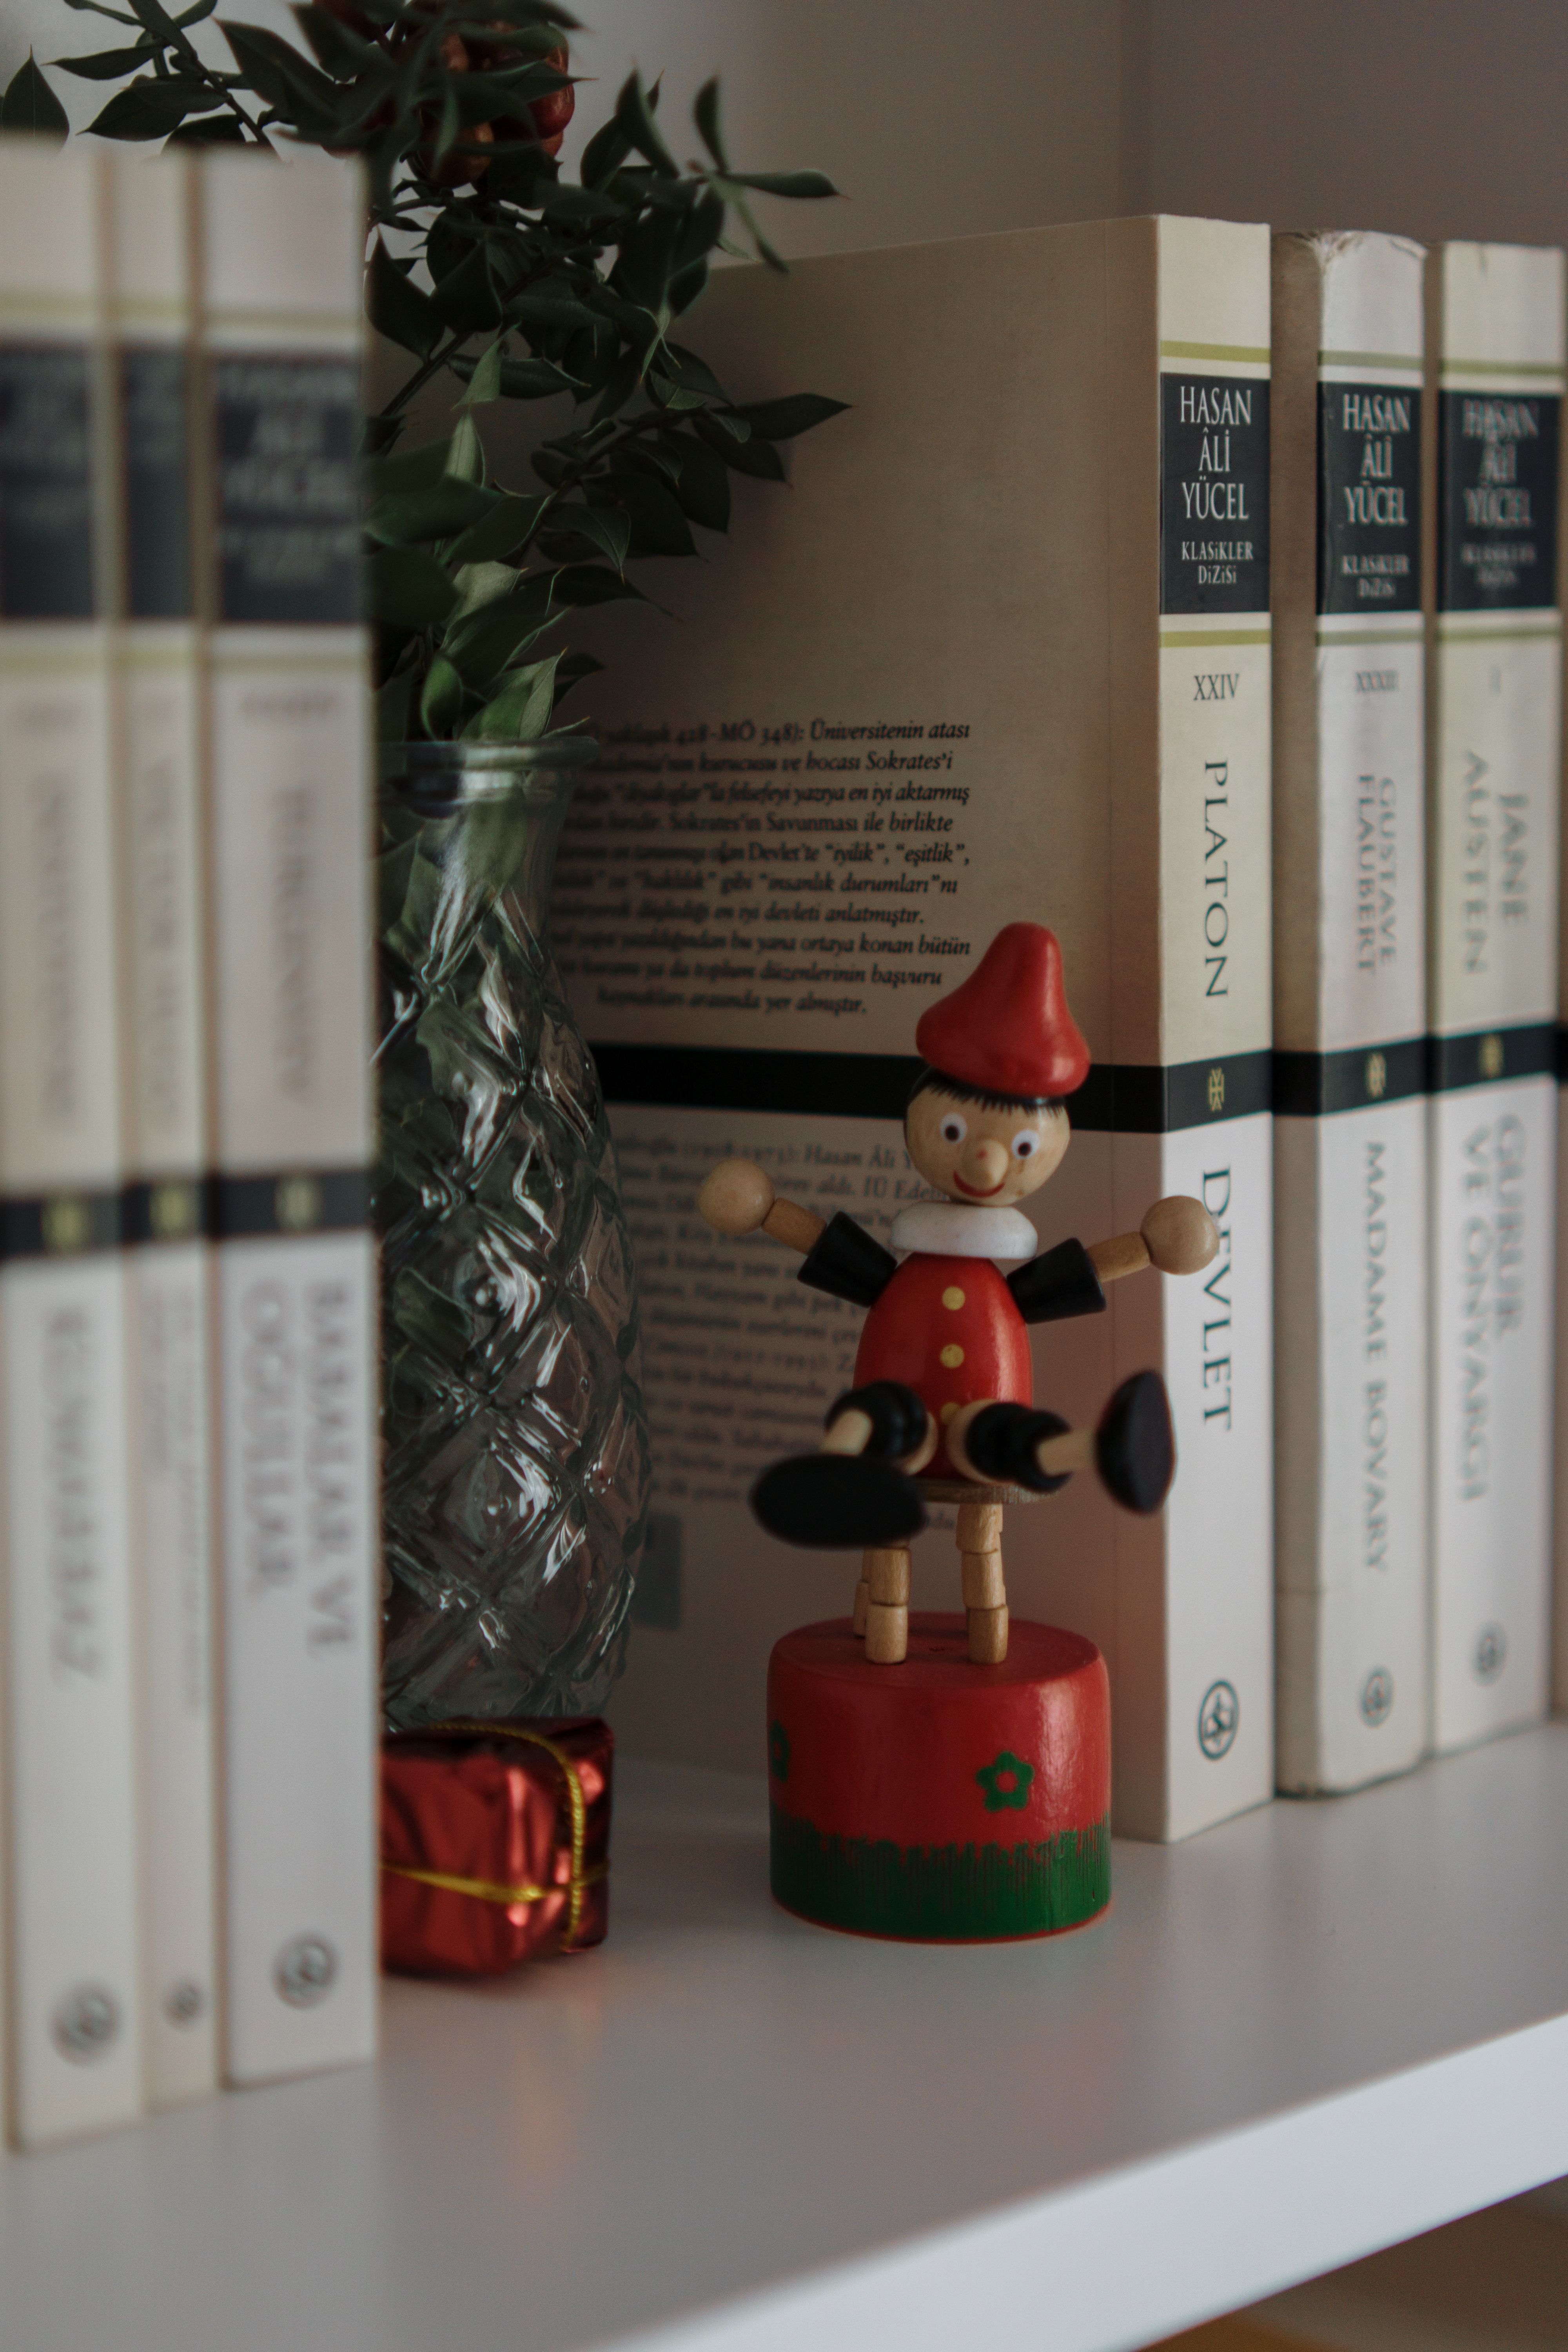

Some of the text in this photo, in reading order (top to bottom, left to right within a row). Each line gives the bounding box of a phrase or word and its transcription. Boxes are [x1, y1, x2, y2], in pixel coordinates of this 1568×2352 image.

[1180, 385, 1252, 425] HASAN
[1343, 393, 1410, 433] HASAN
[1198, 426, 1230, 472] ÂLİ
[1181, 475, 1249, 520] YÜCEL
[1344, 480, 1408, 525] YÜCEL
[1193, 673, 1239, 701] XXIV
[809, 718, 924, 741] Üniversitenin
[928, 722, 970, 739] atası
[806, 750, 861, 771] hocası
[866, 750, 953, 771] Sokrates'i
[848, 788, 869, 802] en
[871, 782, 892, 807] iyi
[895, 780, 970, 806] aktarmış
[766, 811, 858, 832] Savunması
[864, 811, 885, 832] ile
[889, 810, 953, 832] birlikte
[1204, 757, 1229, 998] PLATON
[1357, 774, 1376, 975] FLAUBERT
[1379, 777, 1397, 964] GUSTAVE
[1465, 750, 1489, 975] AUSTEN
[824, 902, 924, 927] anlatmıştır.
[859, 932, 913, 954] konan
[918, 934, 970, 955] bütün
[871, 962, 942, 989] başvuru
[1365, 1140, 1386, 1572] MADAME BOVARY
